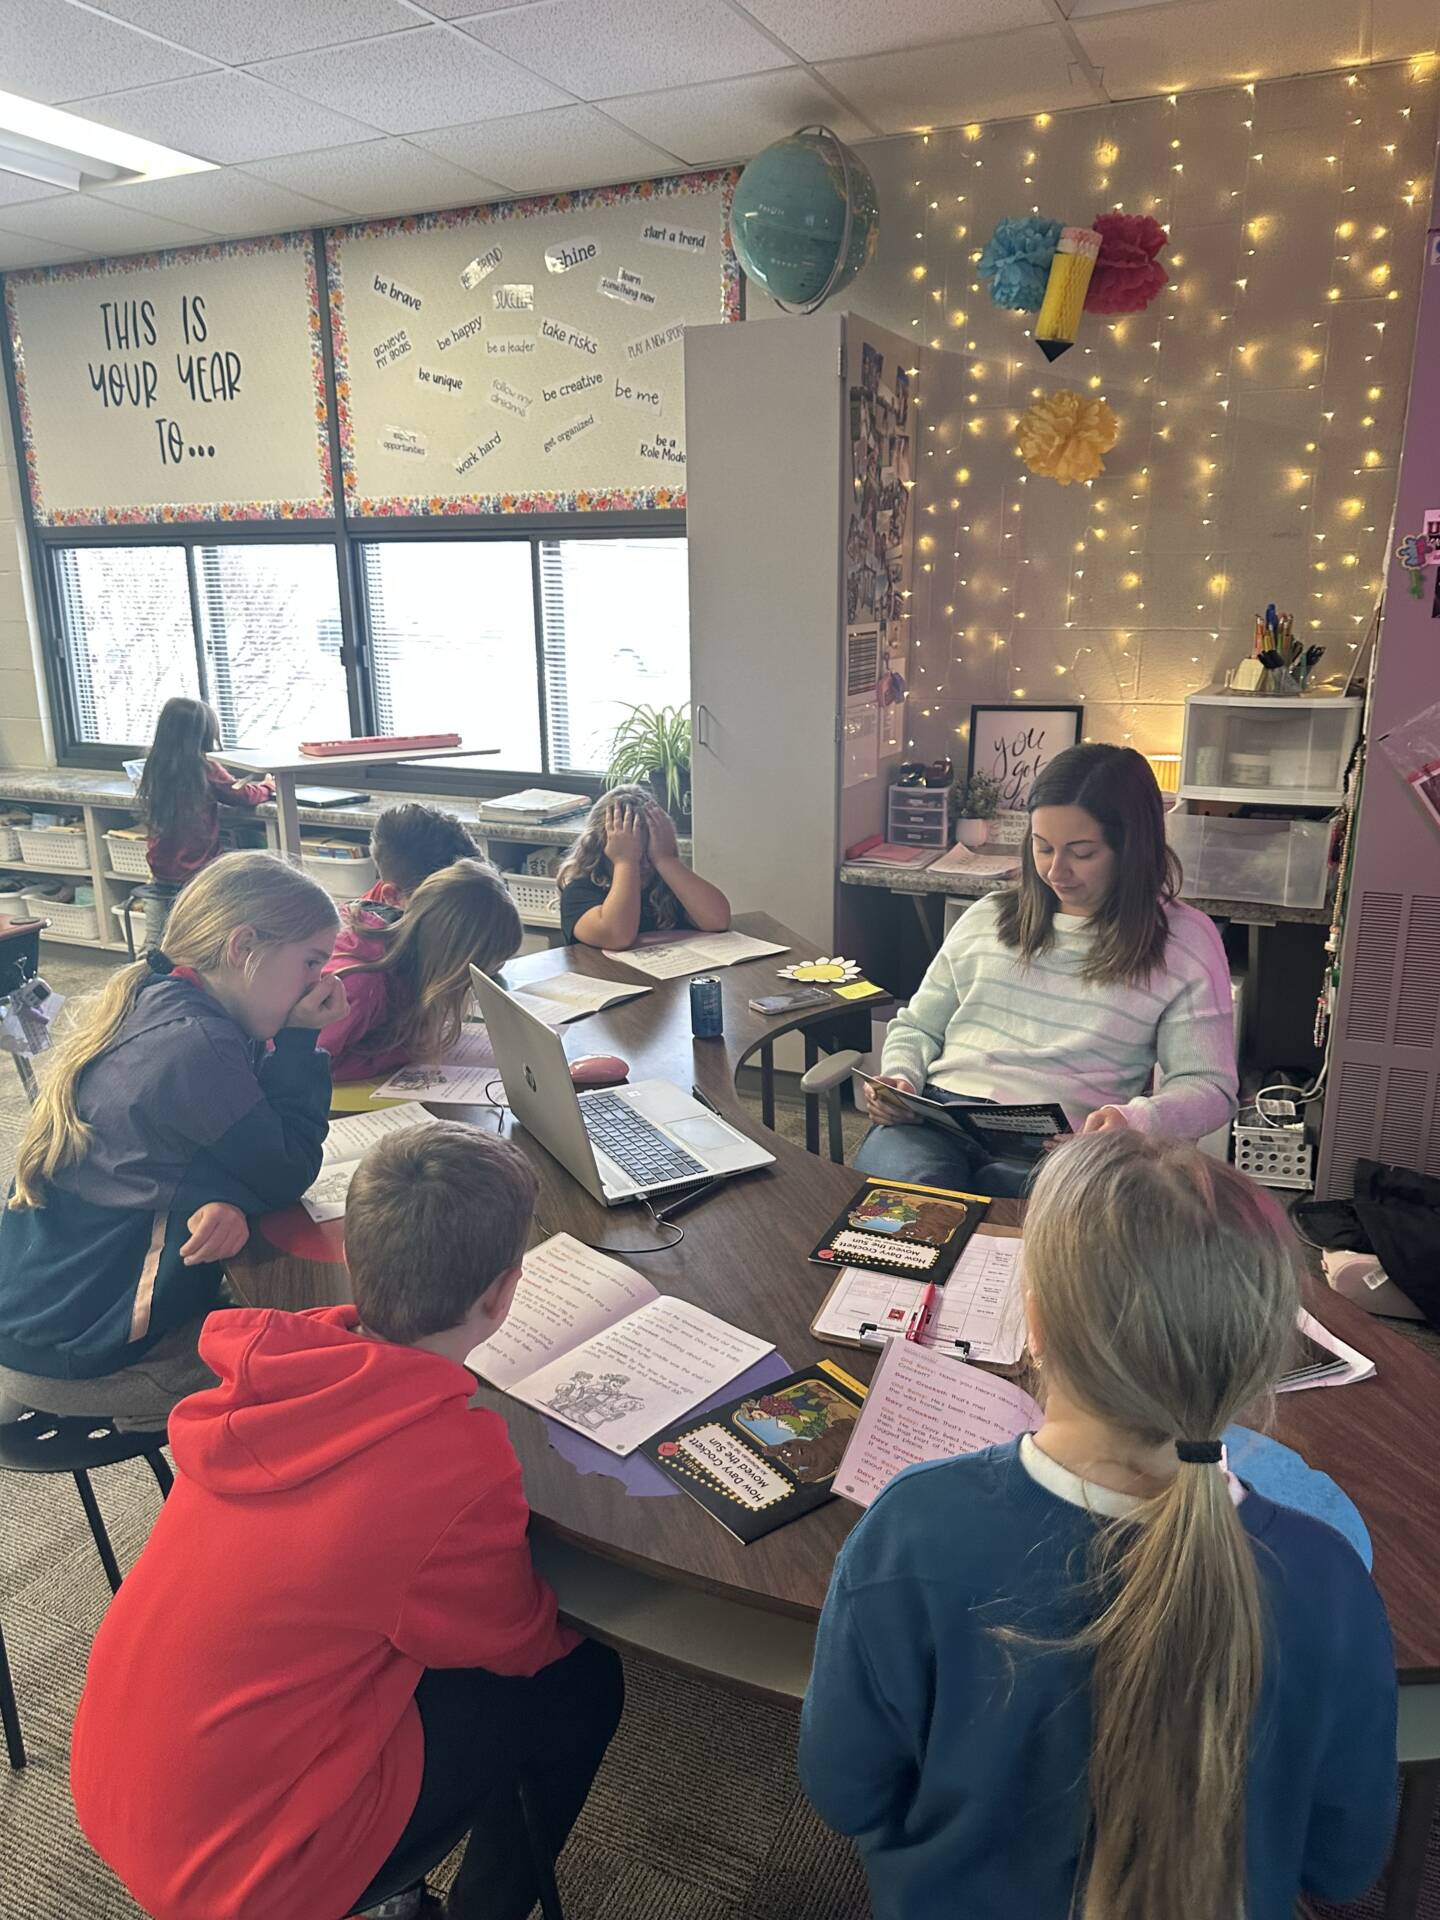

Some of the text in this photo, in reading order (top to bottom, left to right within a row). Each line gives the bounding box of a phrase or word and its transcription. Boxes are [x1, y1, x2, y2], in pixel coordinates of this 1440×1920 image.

[644, 226, 706, 248] start a trend
[621, 270, 641, 286] learn
[374, 275, 422, 311] be brave
[601, 279, 656, 304] something new
[100, 296, 207, 350] THIS IS
[437, 316, 482, 350] be happy
[373, 330, 407, 358] achieve
[487, 342, 499, 354] be
[508, 340, 535, 354] leader
[543, 320, 598, 354] take risks
[390, 341, 412, 361] goals
[88, 351, 241, 408] YOUR YEAR
[419, 368, 463, 392] be unique
[543, 374, 603, 402] be creative
[615, 378, 659, 405] be me
[490, 393, 526, 417] dreams
[492, 379, 532, 408] follow my
[544, 414, 594, 453] get organized
[656, 434, 676, 448] be a
[456, 431, 502, 475] work hard
[640, 444, 686, 464] Role Mode
[992, 727, 1045, 783] you
[1003, 754, 1048, 800] got
[838, 1241, 877, 1253] Crockett
[870, 1241, 886, 1249] the
[879, 1249, 902, 1258] Davy
[887, 1244, 920, 1255] Moved
[903, 1255, 926, 1264] How
[687, 1435, 724, 1468] Crockett
[707, 1436, 769, 1490] Moved the Sun
[720, 1462, 745, 1486] Davy
[742, 1482, 764, 1504] How
